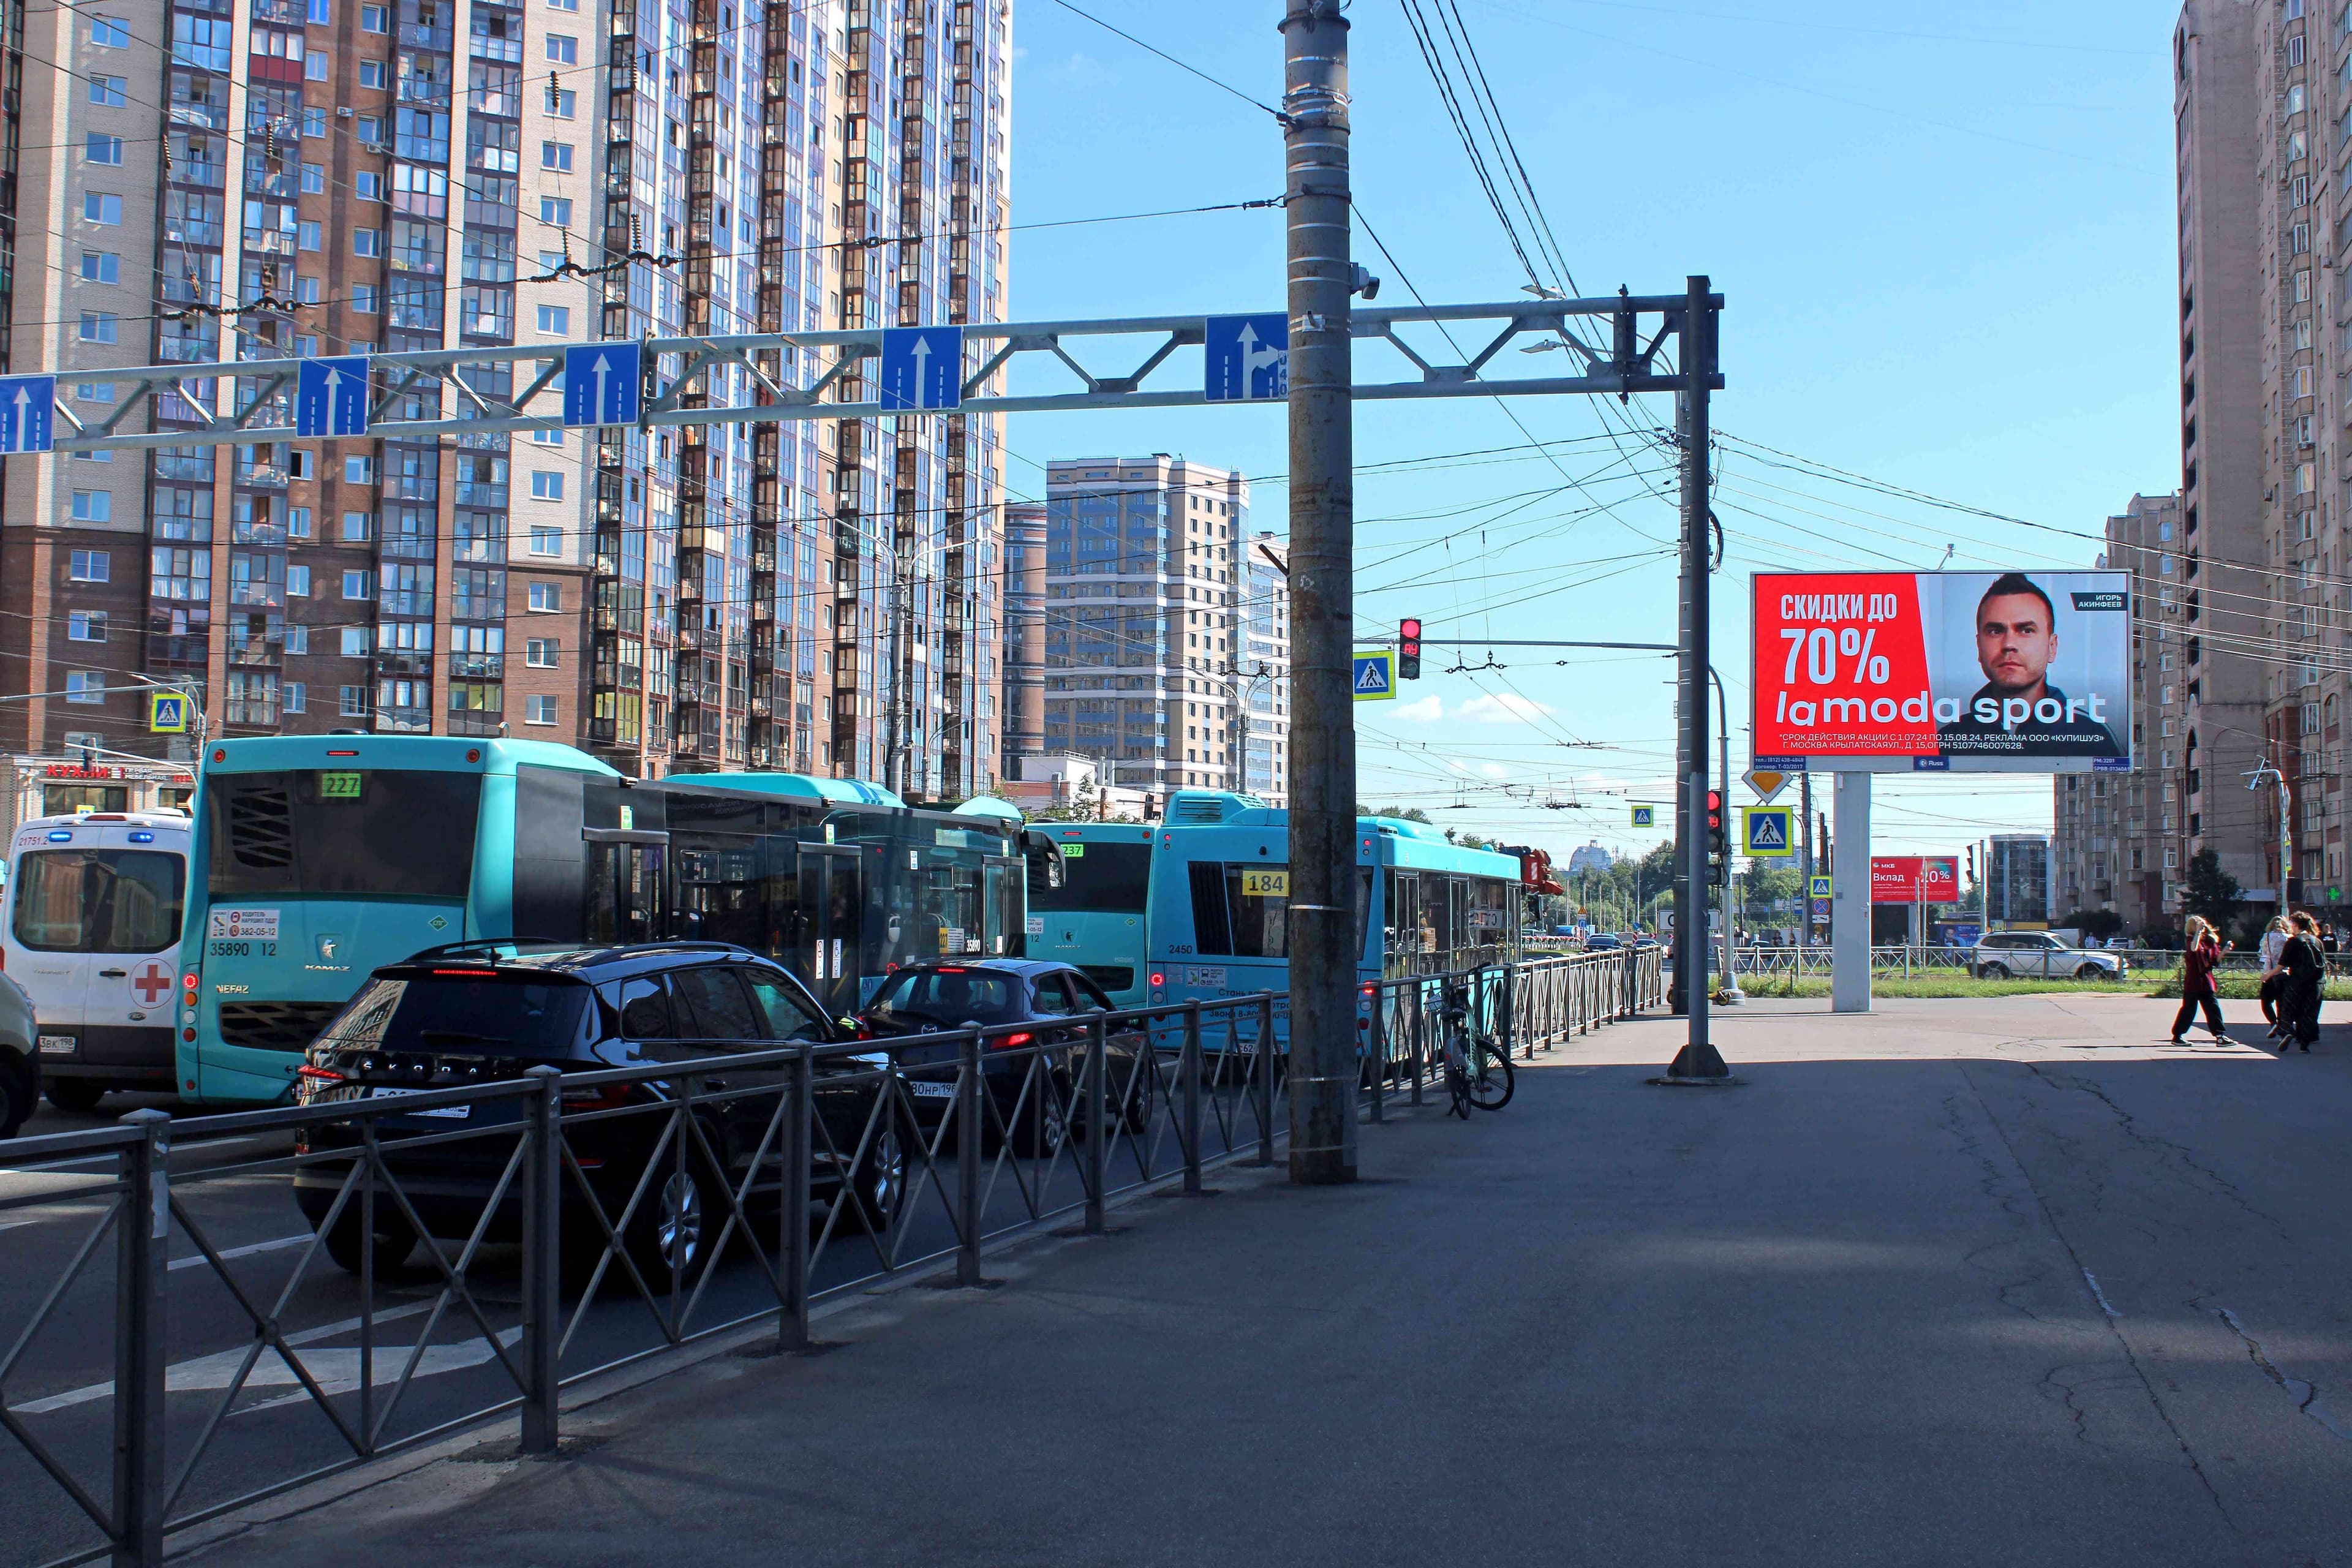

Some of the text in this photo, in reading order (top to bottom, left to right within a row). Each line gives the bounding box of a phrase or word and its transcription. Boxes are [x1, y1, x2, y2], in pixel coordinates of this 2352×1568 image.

[1781, 593, 1897, 623] СКИДКИ ДО
[1780, 627, 1890, 684] 70%
[1776, 691, 2106, 729] lamoda sport
[1807, 733, 1855, 742] ДЕЙСТВИЯ
[326, 777, 359, 794] 227
[18, 836, 48, 846] 21751.2
[1063, 846, 1082, 855] 237
[1873, 873, 1905, 882] Вклад
[1249, 875, 1284, 892] 184
[241, 927, 276, 936] 382-05-12
[211, 943, 276, 956] 35890 12
[1168, 944, 1193, 954] 2450
[216, 985, 250, 994] NEFAZ
[1218, 988, 1246, 997] Стань
[59, 1038, 74, 1046] 198
